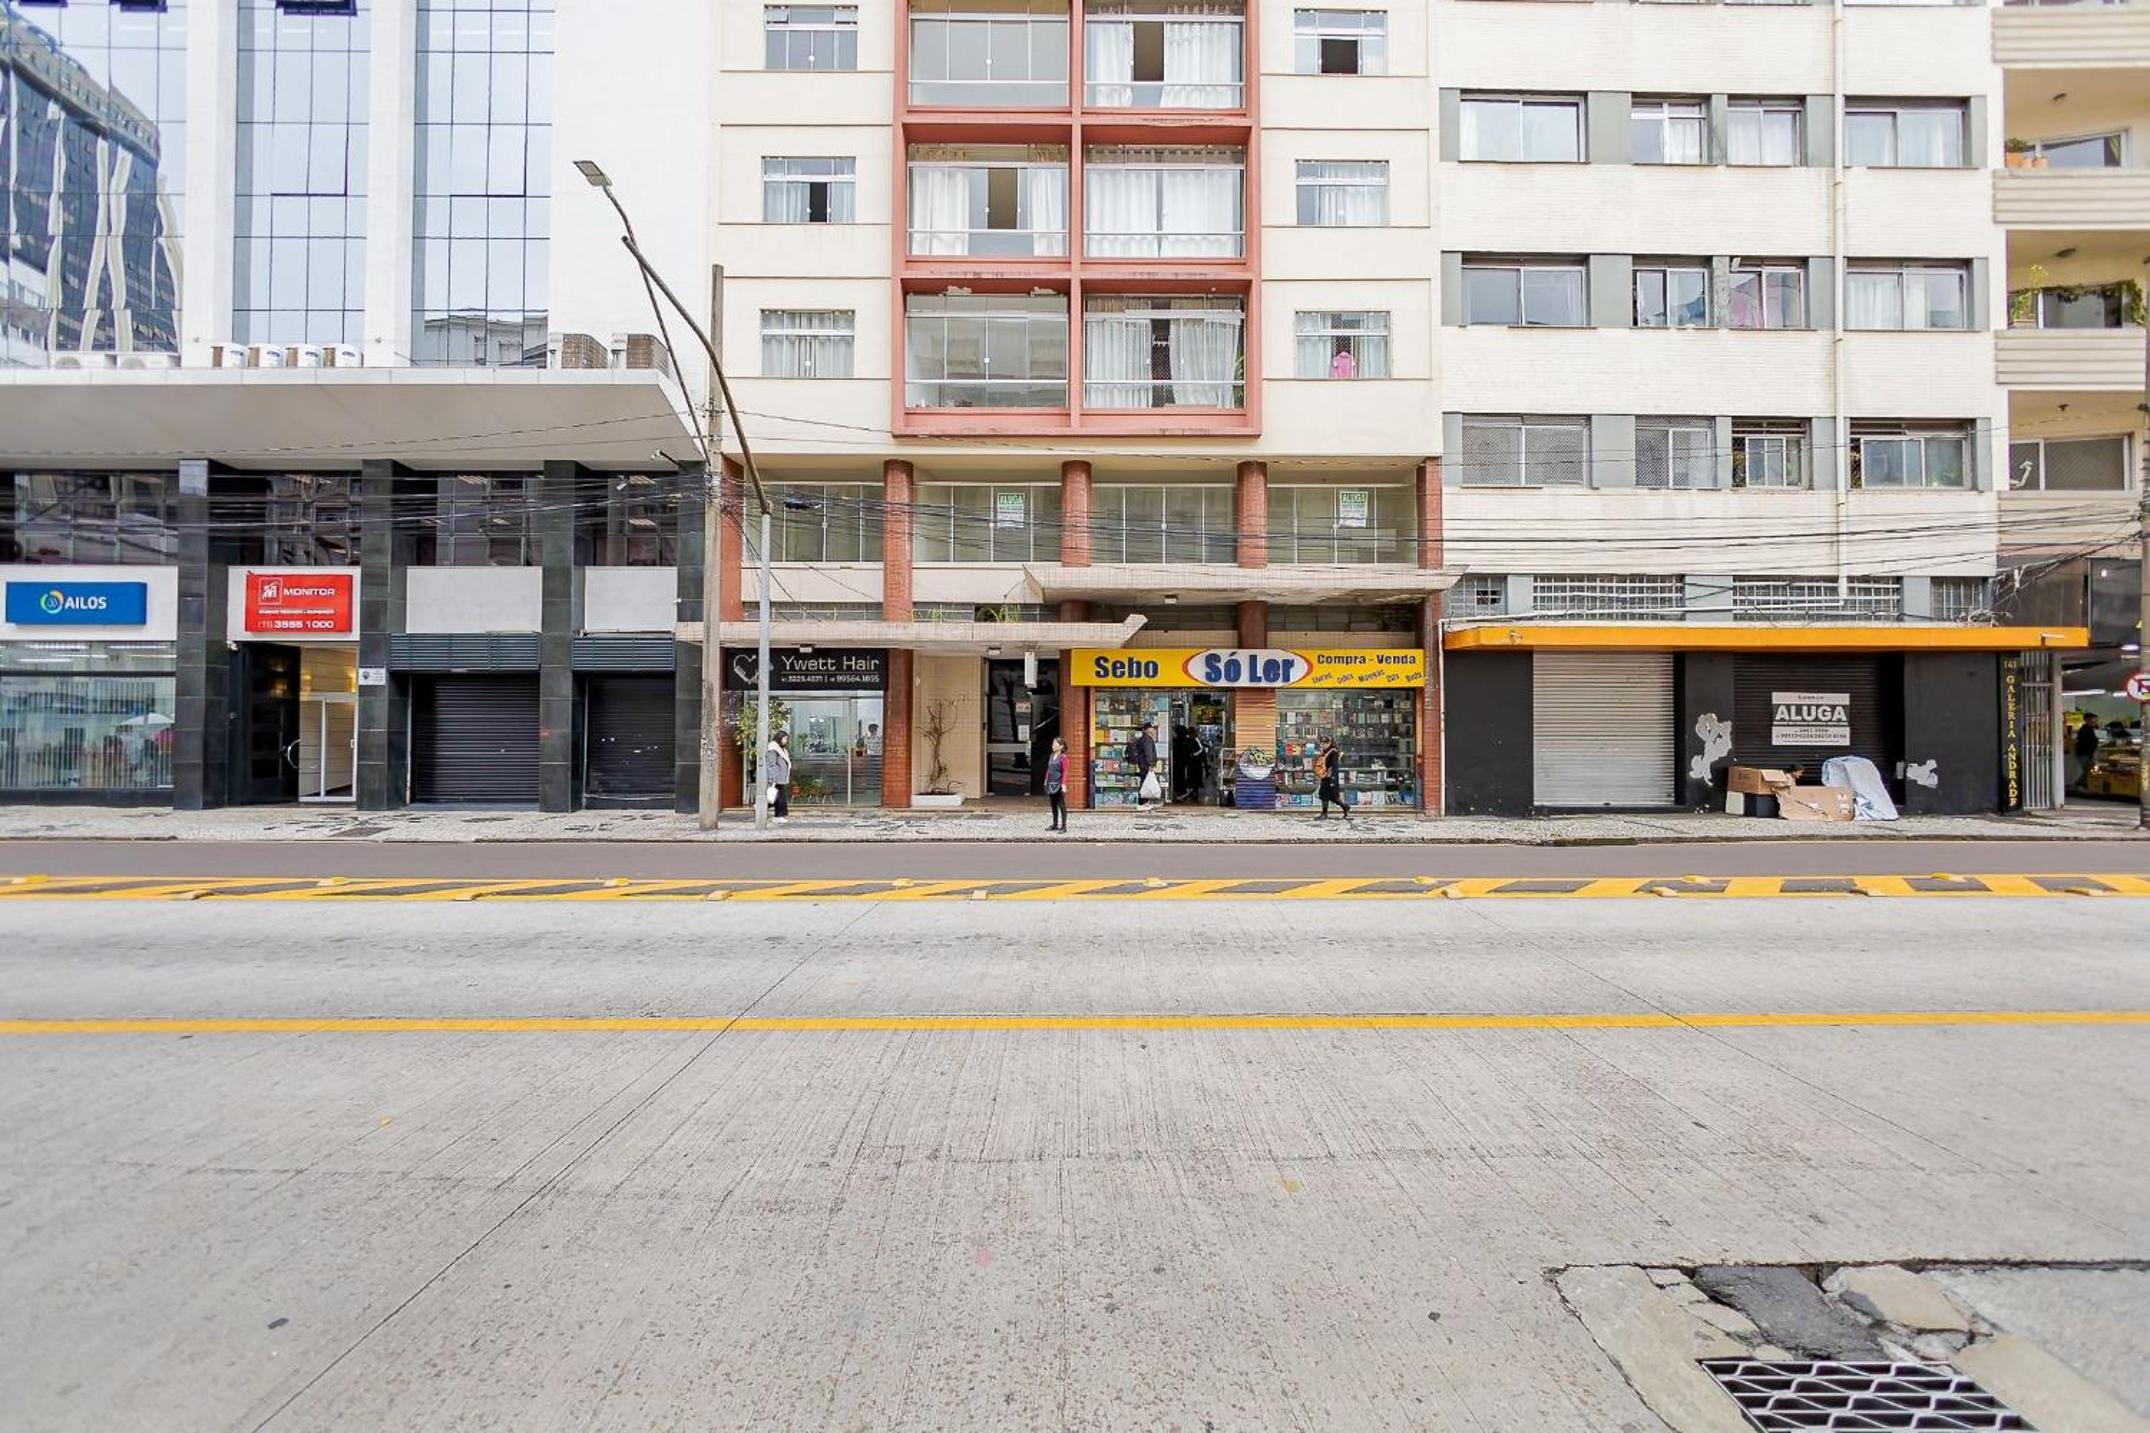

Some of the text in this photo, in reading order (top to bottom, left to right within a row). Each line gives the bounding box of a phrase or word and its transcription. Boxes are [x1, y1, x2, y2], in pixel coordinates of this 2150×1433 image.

[283, 588, 335, 596] MONITOR
[64, 596, 107, 610] AILOS
[305, 620, 334, 629] 1000
[781, 655, 880, 671] Ywett Hair
[1095, 655, 1159, 679] Sebo
[1204, 651, 1295, 683] Só Ler
[1317, 654, 1367, 665] Compra
[1376, 654, 1416, 665] Venda
[1775, 705, 1847, 721] ALUGA
[2006, 676, 2016, 738] GALERIA
